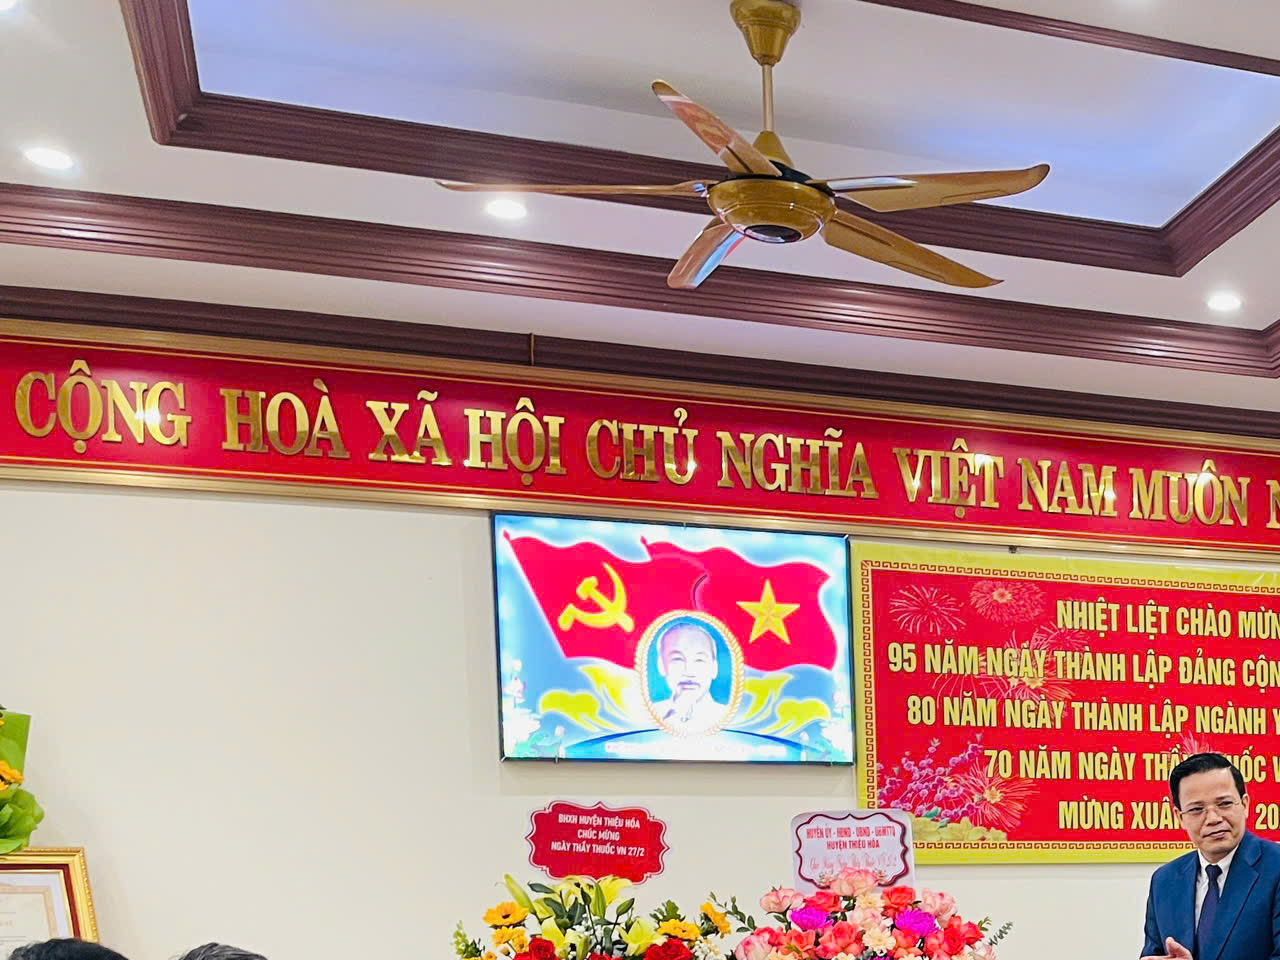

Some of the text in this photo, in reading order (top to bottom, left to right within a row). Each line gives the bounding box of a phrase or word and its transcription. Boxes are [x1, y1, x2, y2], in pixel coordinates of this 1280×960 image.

[15, 359, 192, 455] CỘNG
[219, 377, 351, 459] HOÀ
[366, 390, 453, 467] XÃ
[463, 396, 566, 487] HỘI
[586, 406, 698, 485] CHỦ
[716, 427, 880, 499] NGHĨA
[892, 438, 1004, 518] VIỆT
[1017, 457, 1119, 518] NAM
[1128, 459, 1250, 527] MUÔN
[1056, 596, 1120, 638] NHIỆT
[1126, 599, 1170, 640] LIỆT
[1176, 602, 1232, 638] CHÀO
[887, 642, 917, 673] 95
[924, 638, 979, 675] NĂM
[986, 640, 1047, 678] NGÀY
[1053, 645, 1126, 682] THÀNH
[1132, 648, 1173, 690] LẬP
[1178, 647, 1236, 687] ĐẢNG
[907, 695, 936, 726] 80
[943, 690, 998, 728] NĂM
[1004, 693, 1065, 730] NGÀY
[1071, 696, 1143, 732] THÀNH
[1149, 698, 1189, 739] LẬP
[1195, 701, 1267, 735] NGÀNH
[983, 750, 1012, 779] 70
[1019, 744, 1071, 780] NĂM
[1078, 746, 1136, 781] NGÀY
[1142, 743, 1194, 781] THẦ
[577, 827, 597, 839] CHÚC
[1058, 795, 1124, 830] MỪNG
[551, 840, 571, 852] NGÀY
[616, 845, 627, 855] VN
[628, 846, 645, 857] 27/2
